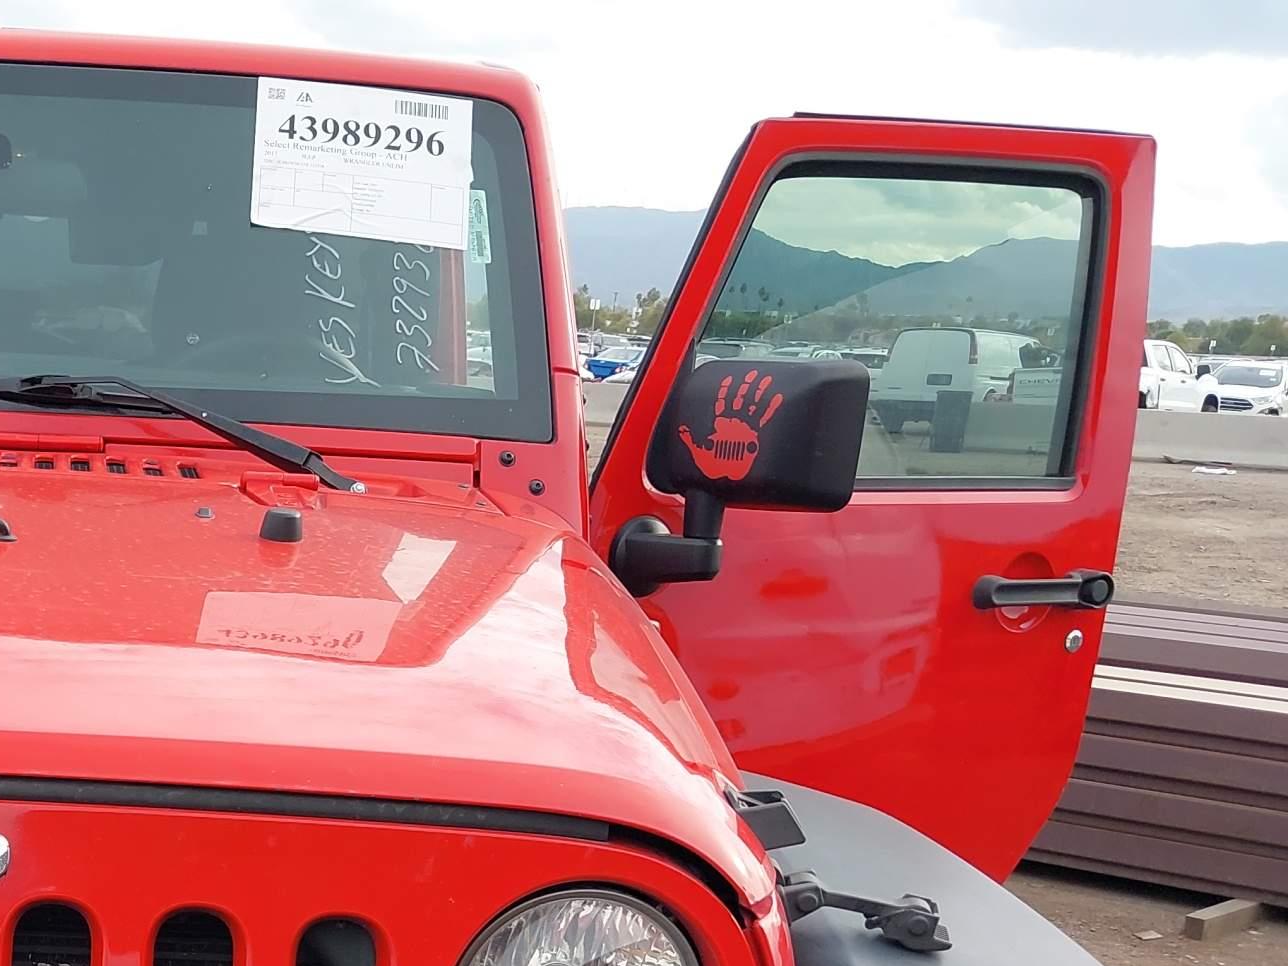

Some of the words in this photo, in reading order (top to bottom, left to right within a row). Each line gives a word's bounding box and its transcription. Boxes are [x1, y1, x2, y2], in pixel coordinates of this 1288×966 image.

[264, 139, 290, 149] Select
[293, 141, 347, 156] Remarketing
[350, 148, 377, 159] Group
[385, 152, 408, 161] ACH
[279, 114, 447, 157] 43989296
[303, 235, 356, 308] KEY
[319, 317, 382, 388] YES
